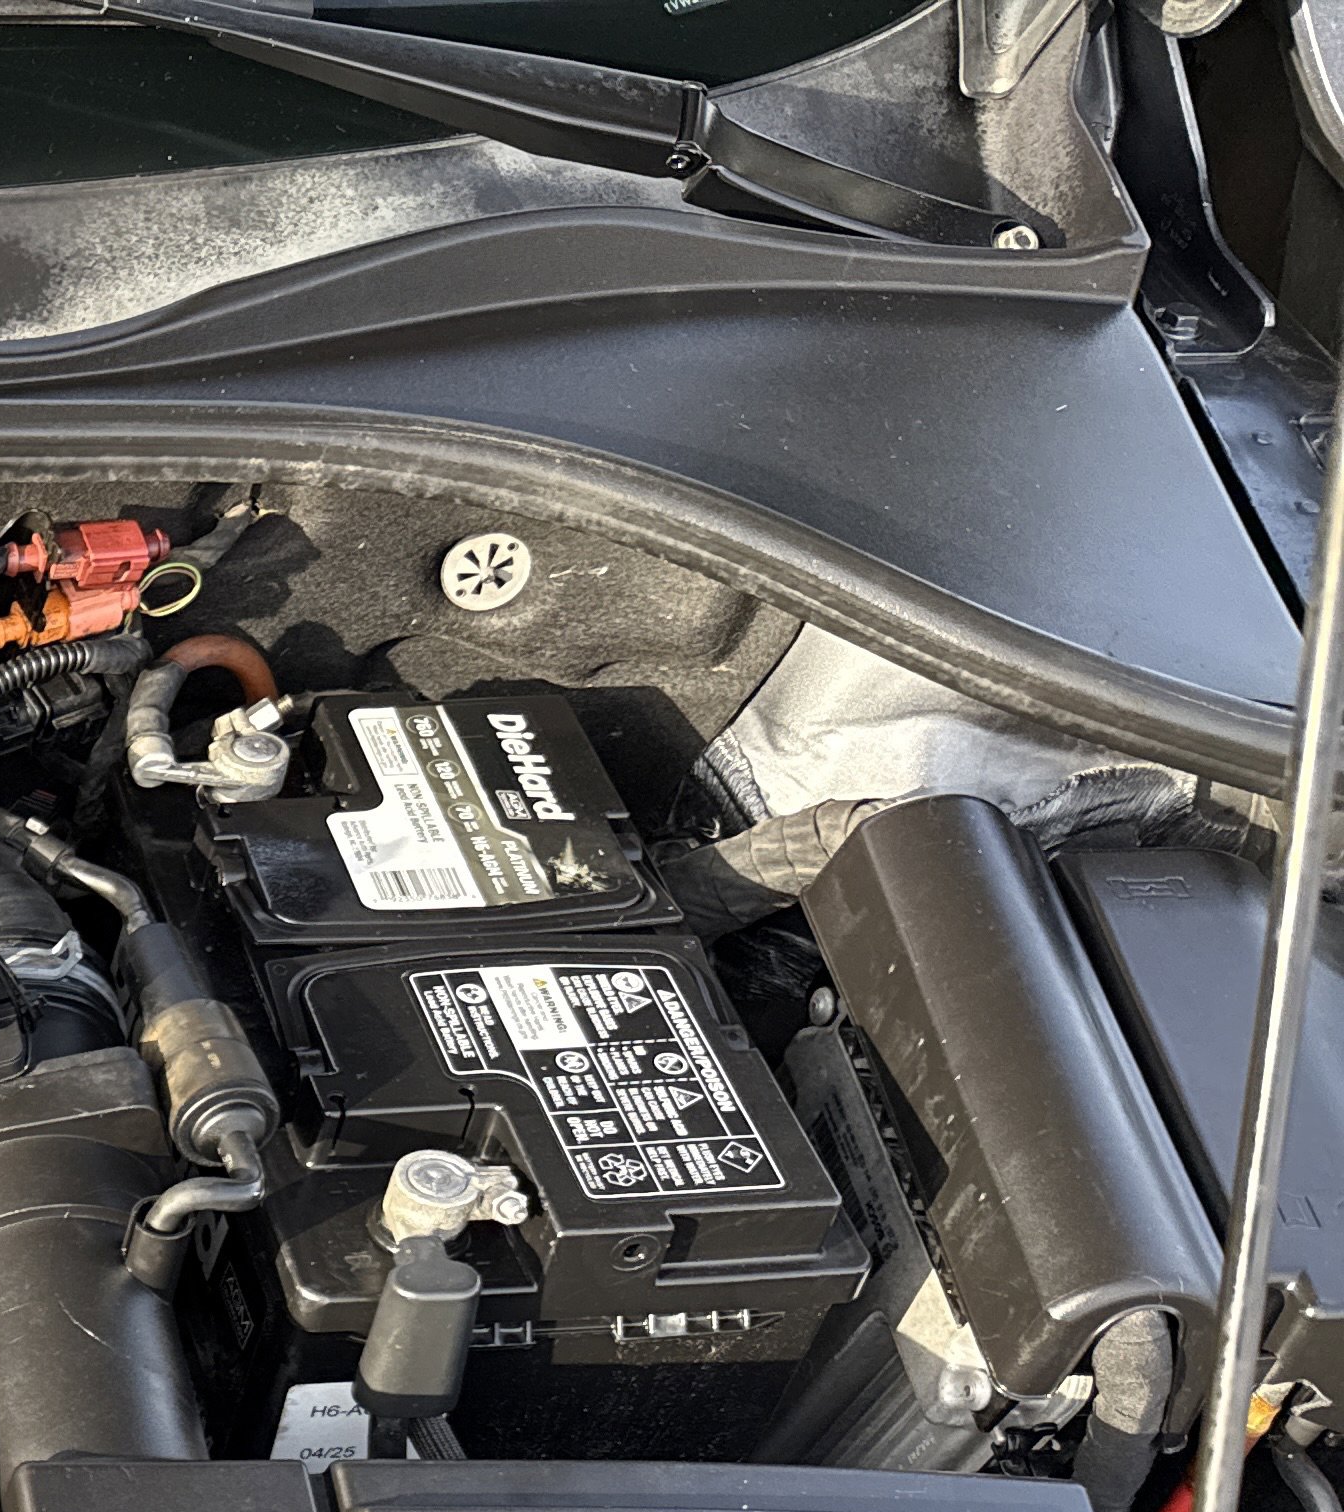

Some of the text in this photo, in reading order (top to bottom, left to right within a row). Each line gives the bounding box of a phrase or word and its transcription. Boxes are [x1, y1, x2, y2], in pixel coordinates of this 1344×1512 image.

[412, 718, 434, 736] 760
[434, 762, 455, 778] 120
[486, 712, 575, 822] DieHard
[455, 805, 475, 819] 70
[501, 840, 539, 894] PLATINUM
[430, 986, 476, 1057] NON-SPILLABLE
[665, 1001, 735, 1111] DANGER/POISON
[583, 1119, 603, 1137] NOT
[599, 1120, 618, 1134] DO
[310, 1404, 370, 1418] H6-A
[299, 1446, 356, 1460] 04/25
